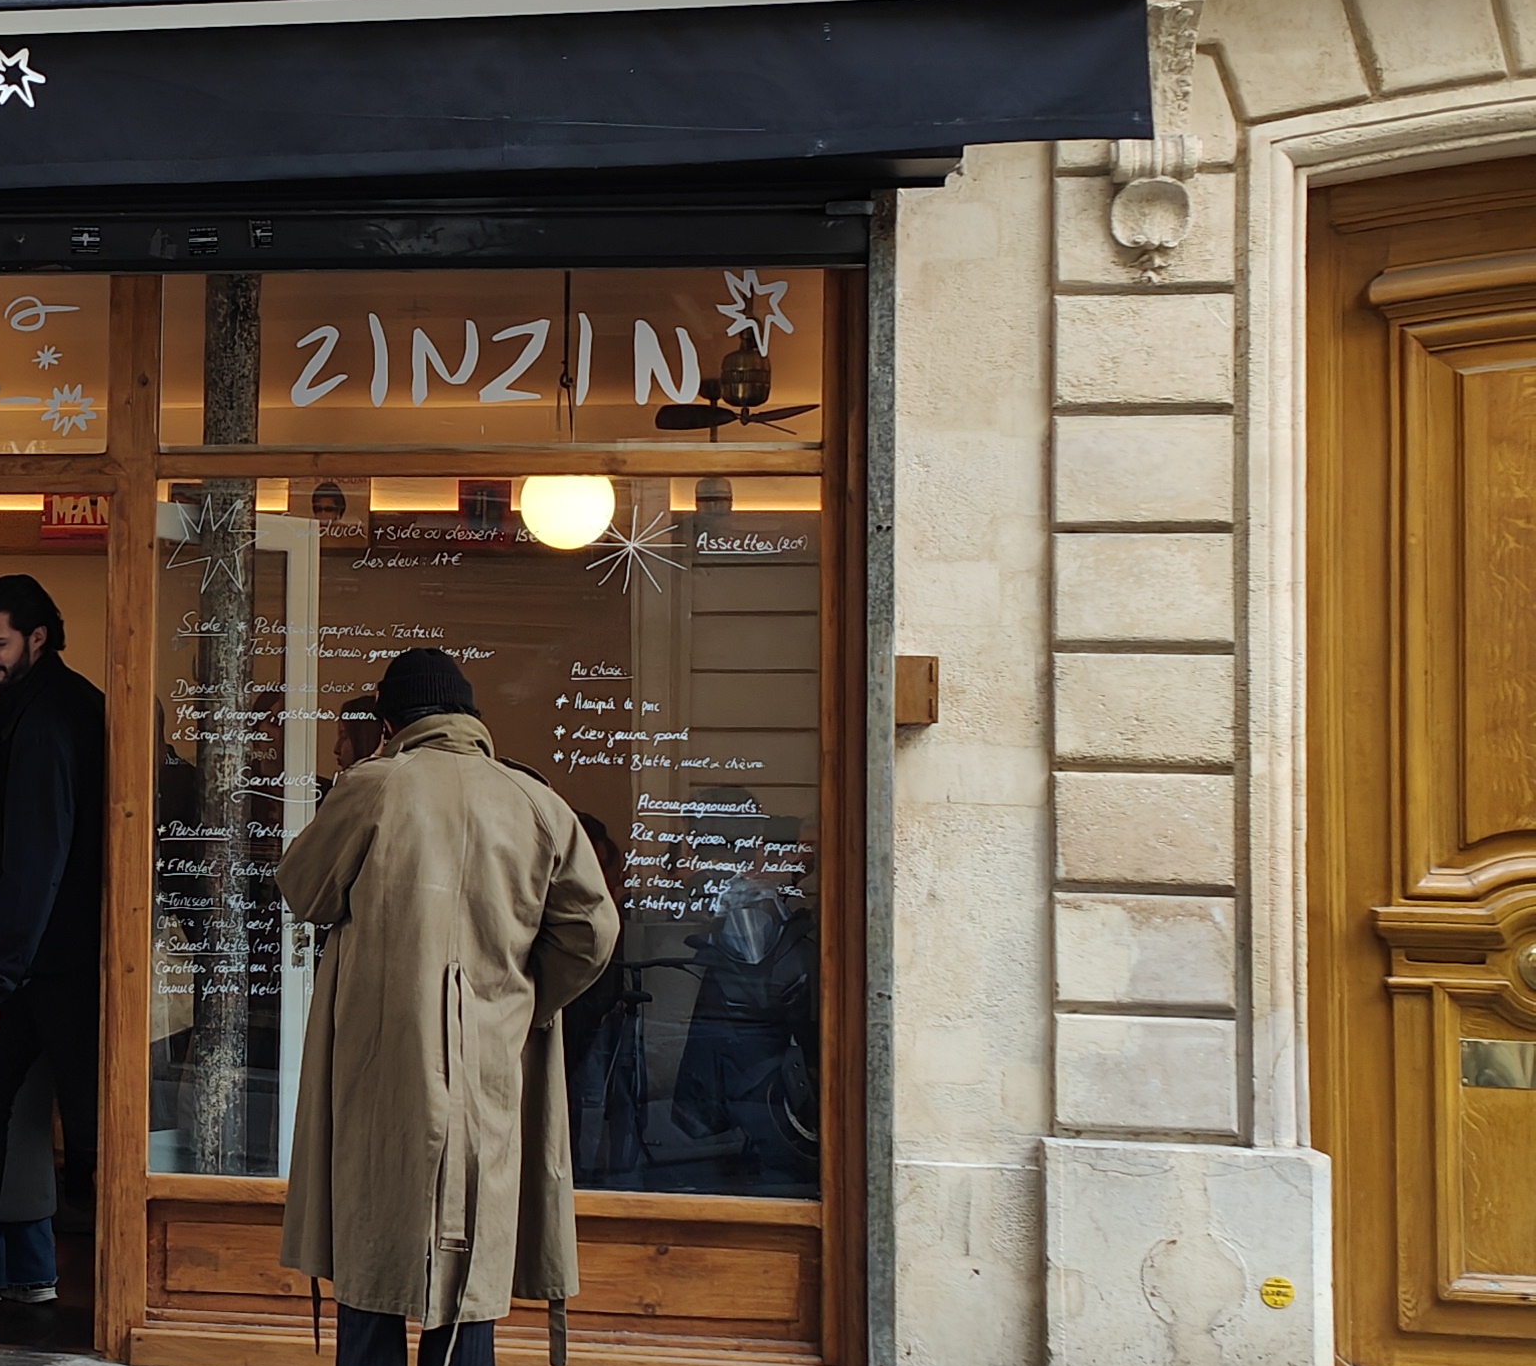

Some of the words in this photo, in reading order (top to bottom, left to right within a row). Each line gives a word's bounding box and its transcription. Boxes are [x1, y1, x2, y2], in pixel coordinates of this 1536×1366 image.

[290, 313, 701, 406] ZINZIN
[696, 531, 773, 551] Assiettes
[571, 661, 587, 676] Au
[184, 726, 220, 744] Sirop
[235, 766, 321, 787] Sandwich
[246, 821, 298, 839] Pastram
[630, 823, 654, 841] Riz
[155, 961, 207, 976] Carottes
